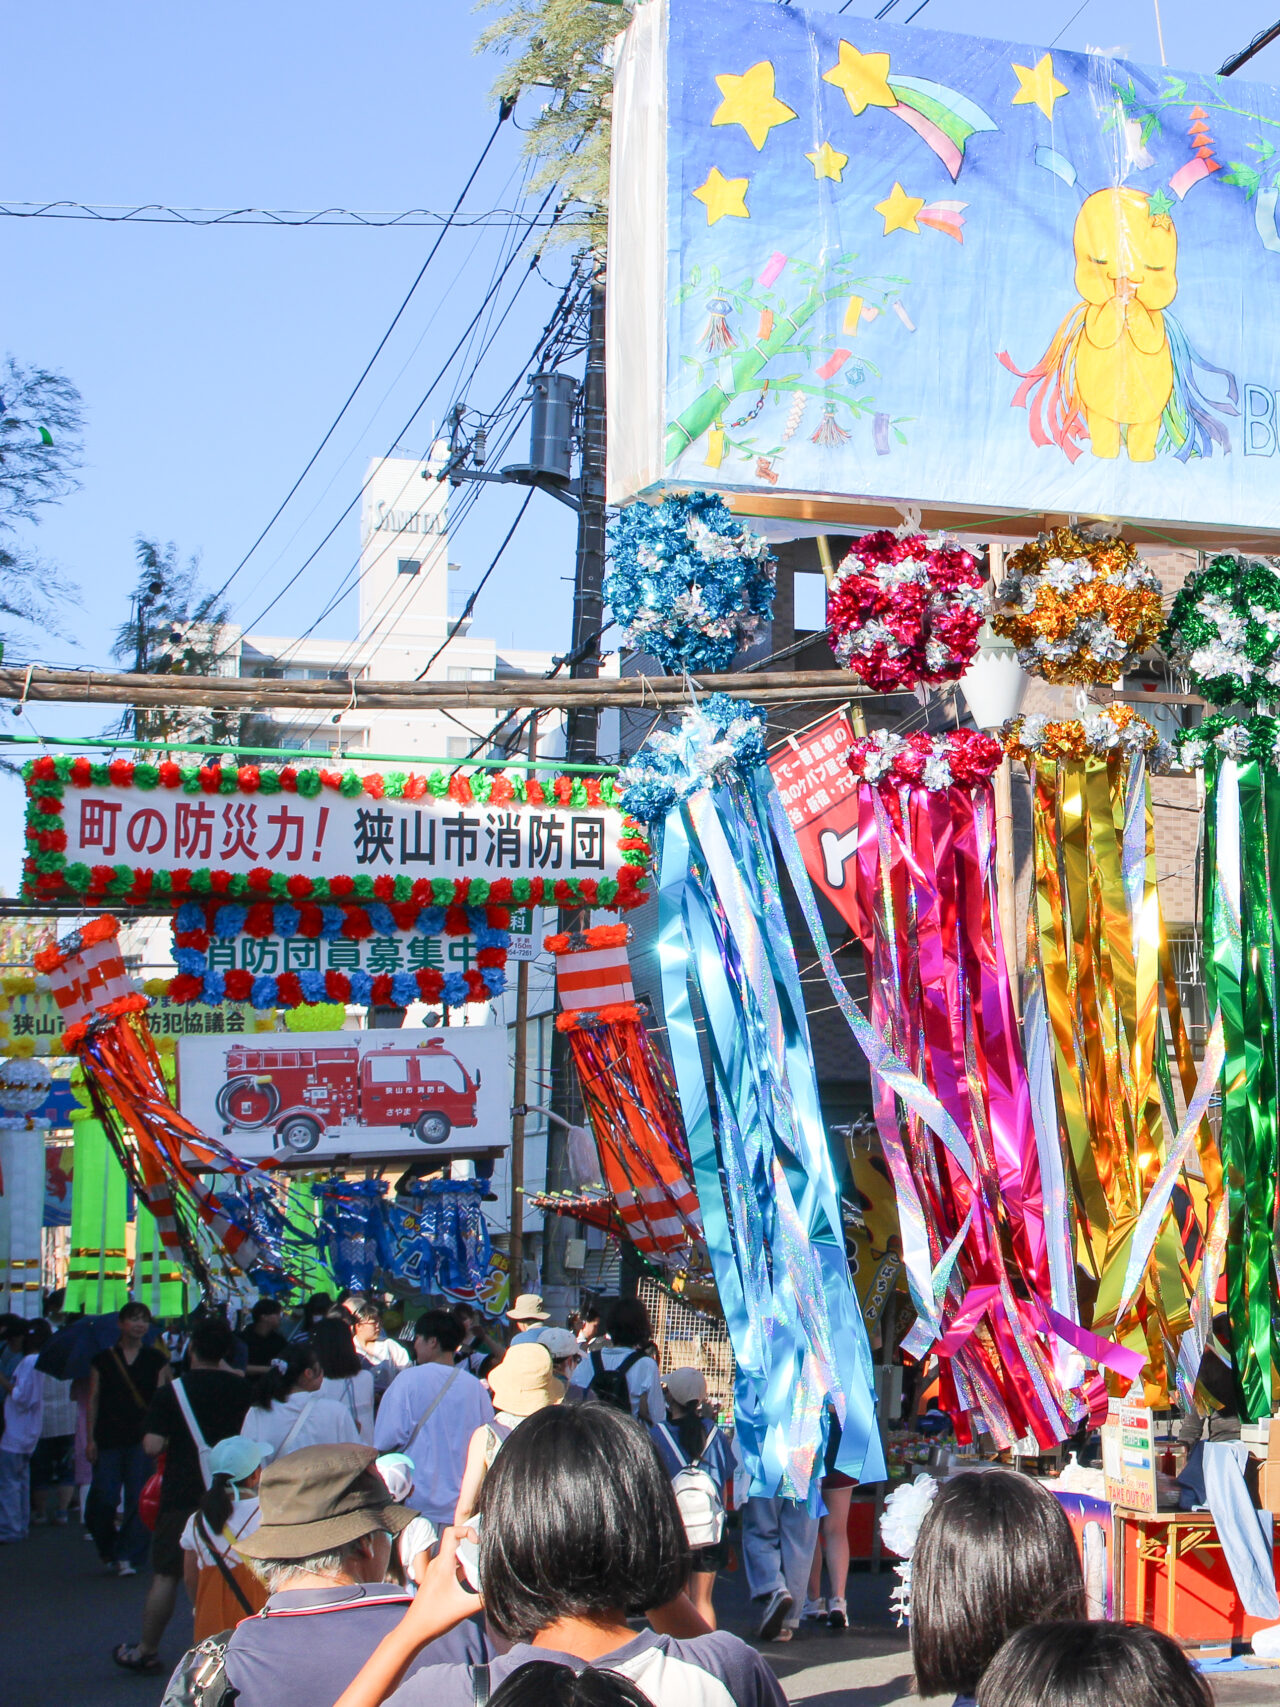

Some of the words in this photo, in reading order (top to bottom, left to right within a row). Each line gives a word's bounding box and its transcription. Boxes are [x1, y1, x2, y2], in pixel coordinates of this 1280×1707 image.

[79, 798, 329, 863] 町の防災力!
[354, 808, 606, 871] 狭山市消防団
[207, 936, 478, 974] 消防団員募集中
[386, 1107, 411, 1116] さやま
[1108, 1485, 1125, 1502] TAKE
[1126, 1489, 1140, 1505] OUT
